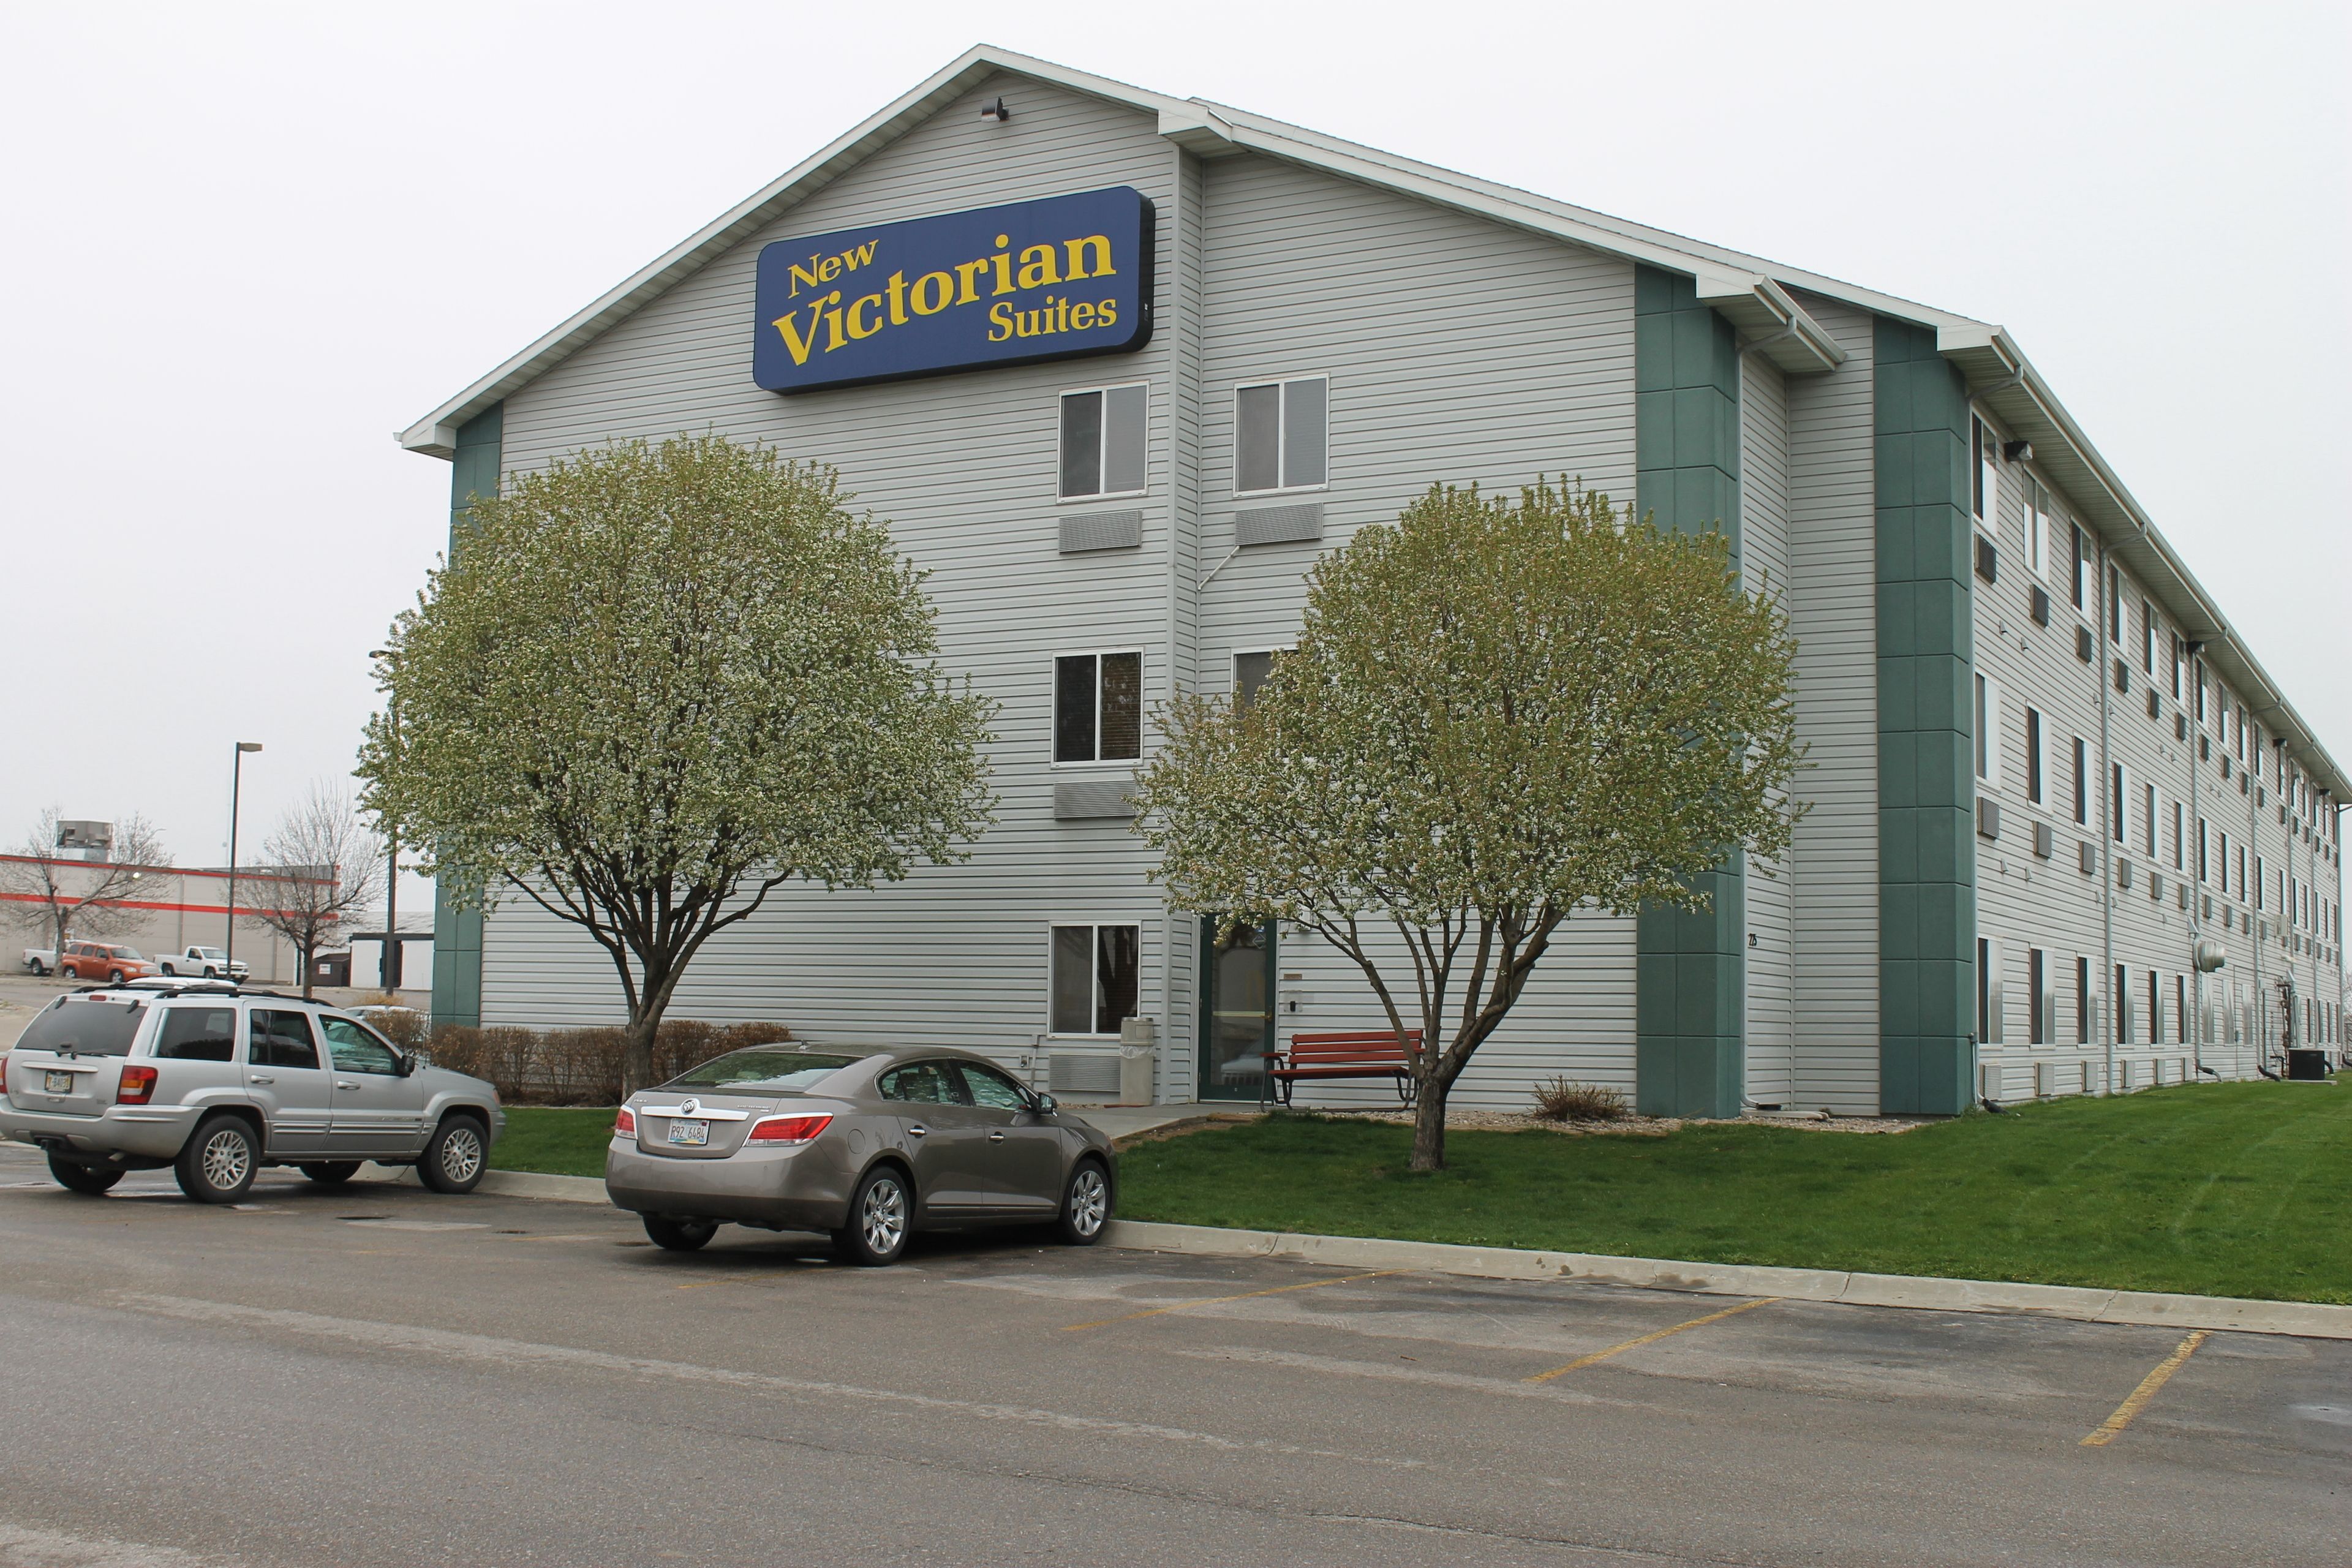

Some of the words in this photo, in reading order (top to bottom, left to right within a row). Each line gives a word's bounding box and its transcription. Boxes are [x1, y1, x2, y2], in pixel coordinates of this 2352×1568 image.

[787, 239, 880, 300] New
[771, 233, 1118, 366] Victorian
[988, 296, 1118, 342] Suites
[671, 1126, 685, 1138] R92
[688, 1126, 705, 1139] 6484
